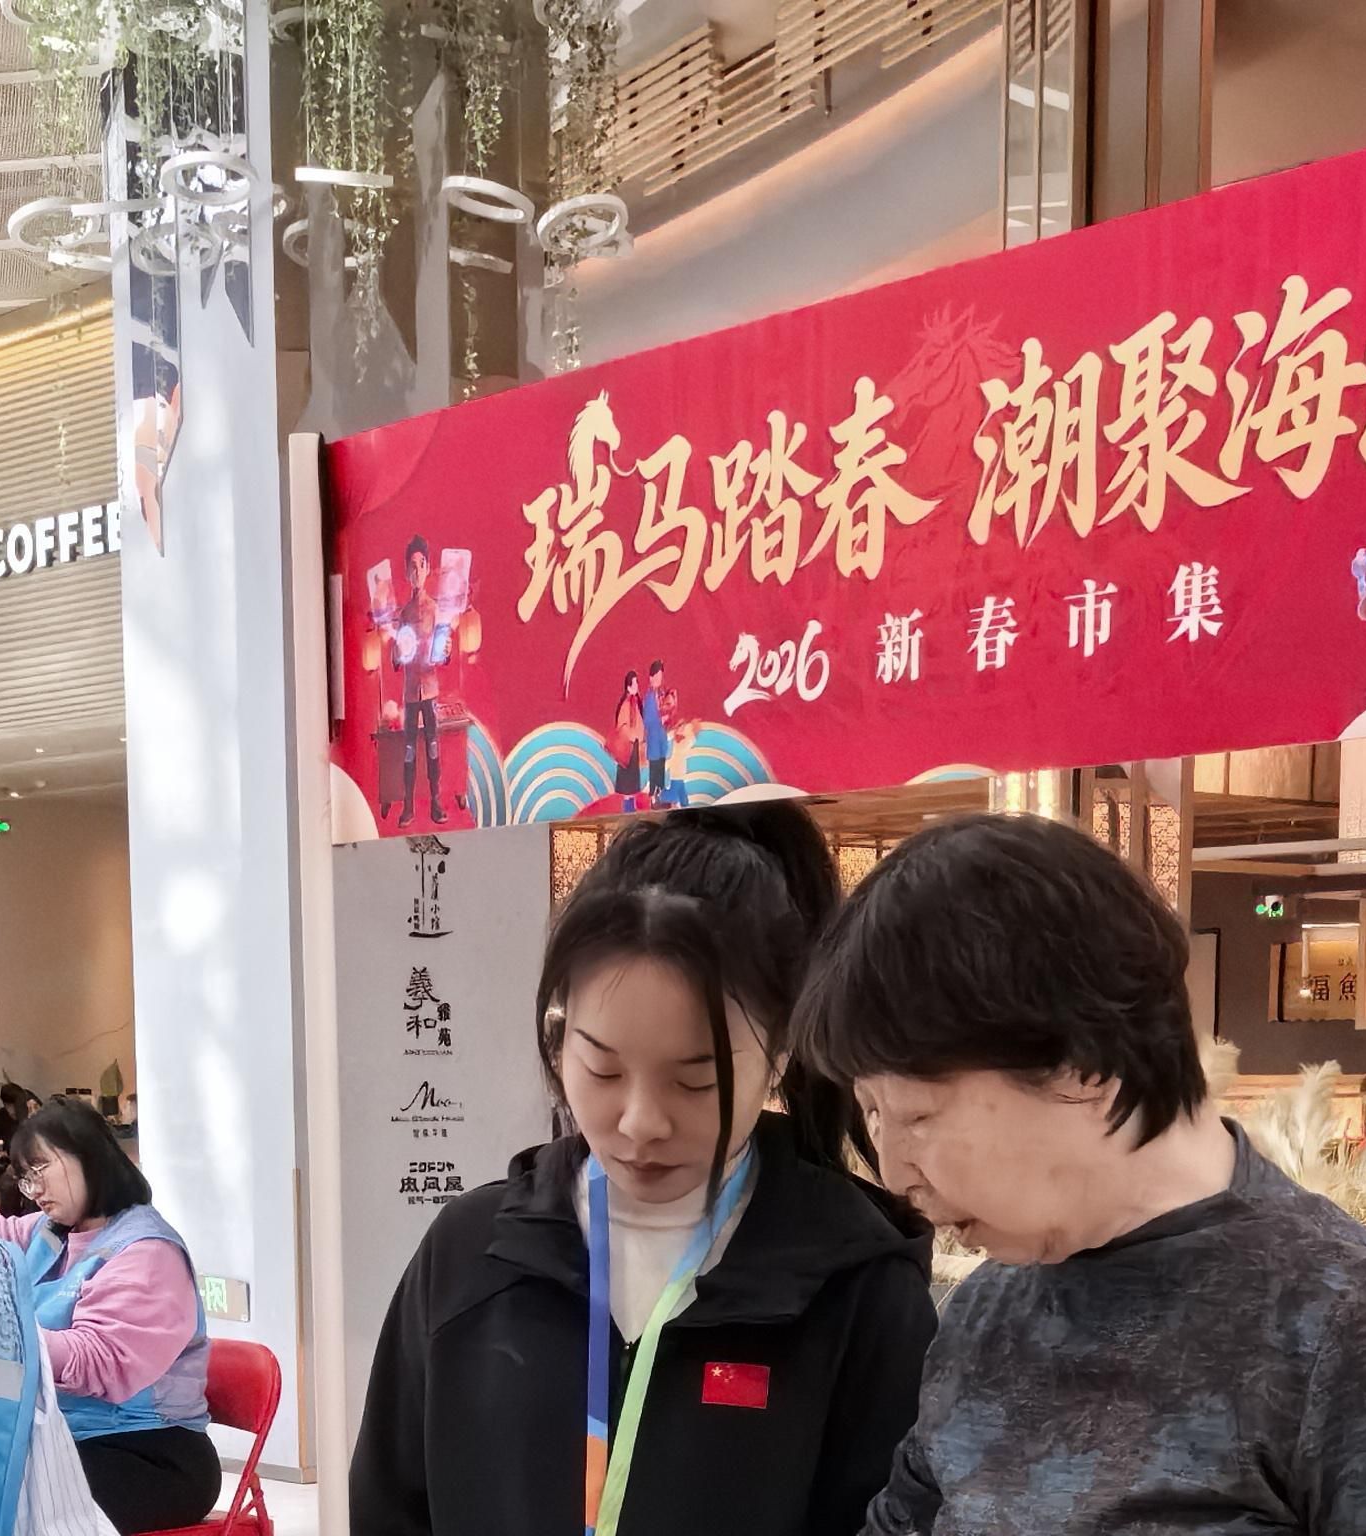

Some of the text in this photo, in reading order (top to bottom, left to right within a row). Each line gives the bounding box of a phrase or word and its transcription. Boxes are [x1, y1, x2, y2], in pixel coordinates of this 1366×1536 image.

[516, 375, 942, 701] 瑞马踏春
[722, 561, 1223, 718] 2026 新春市集
